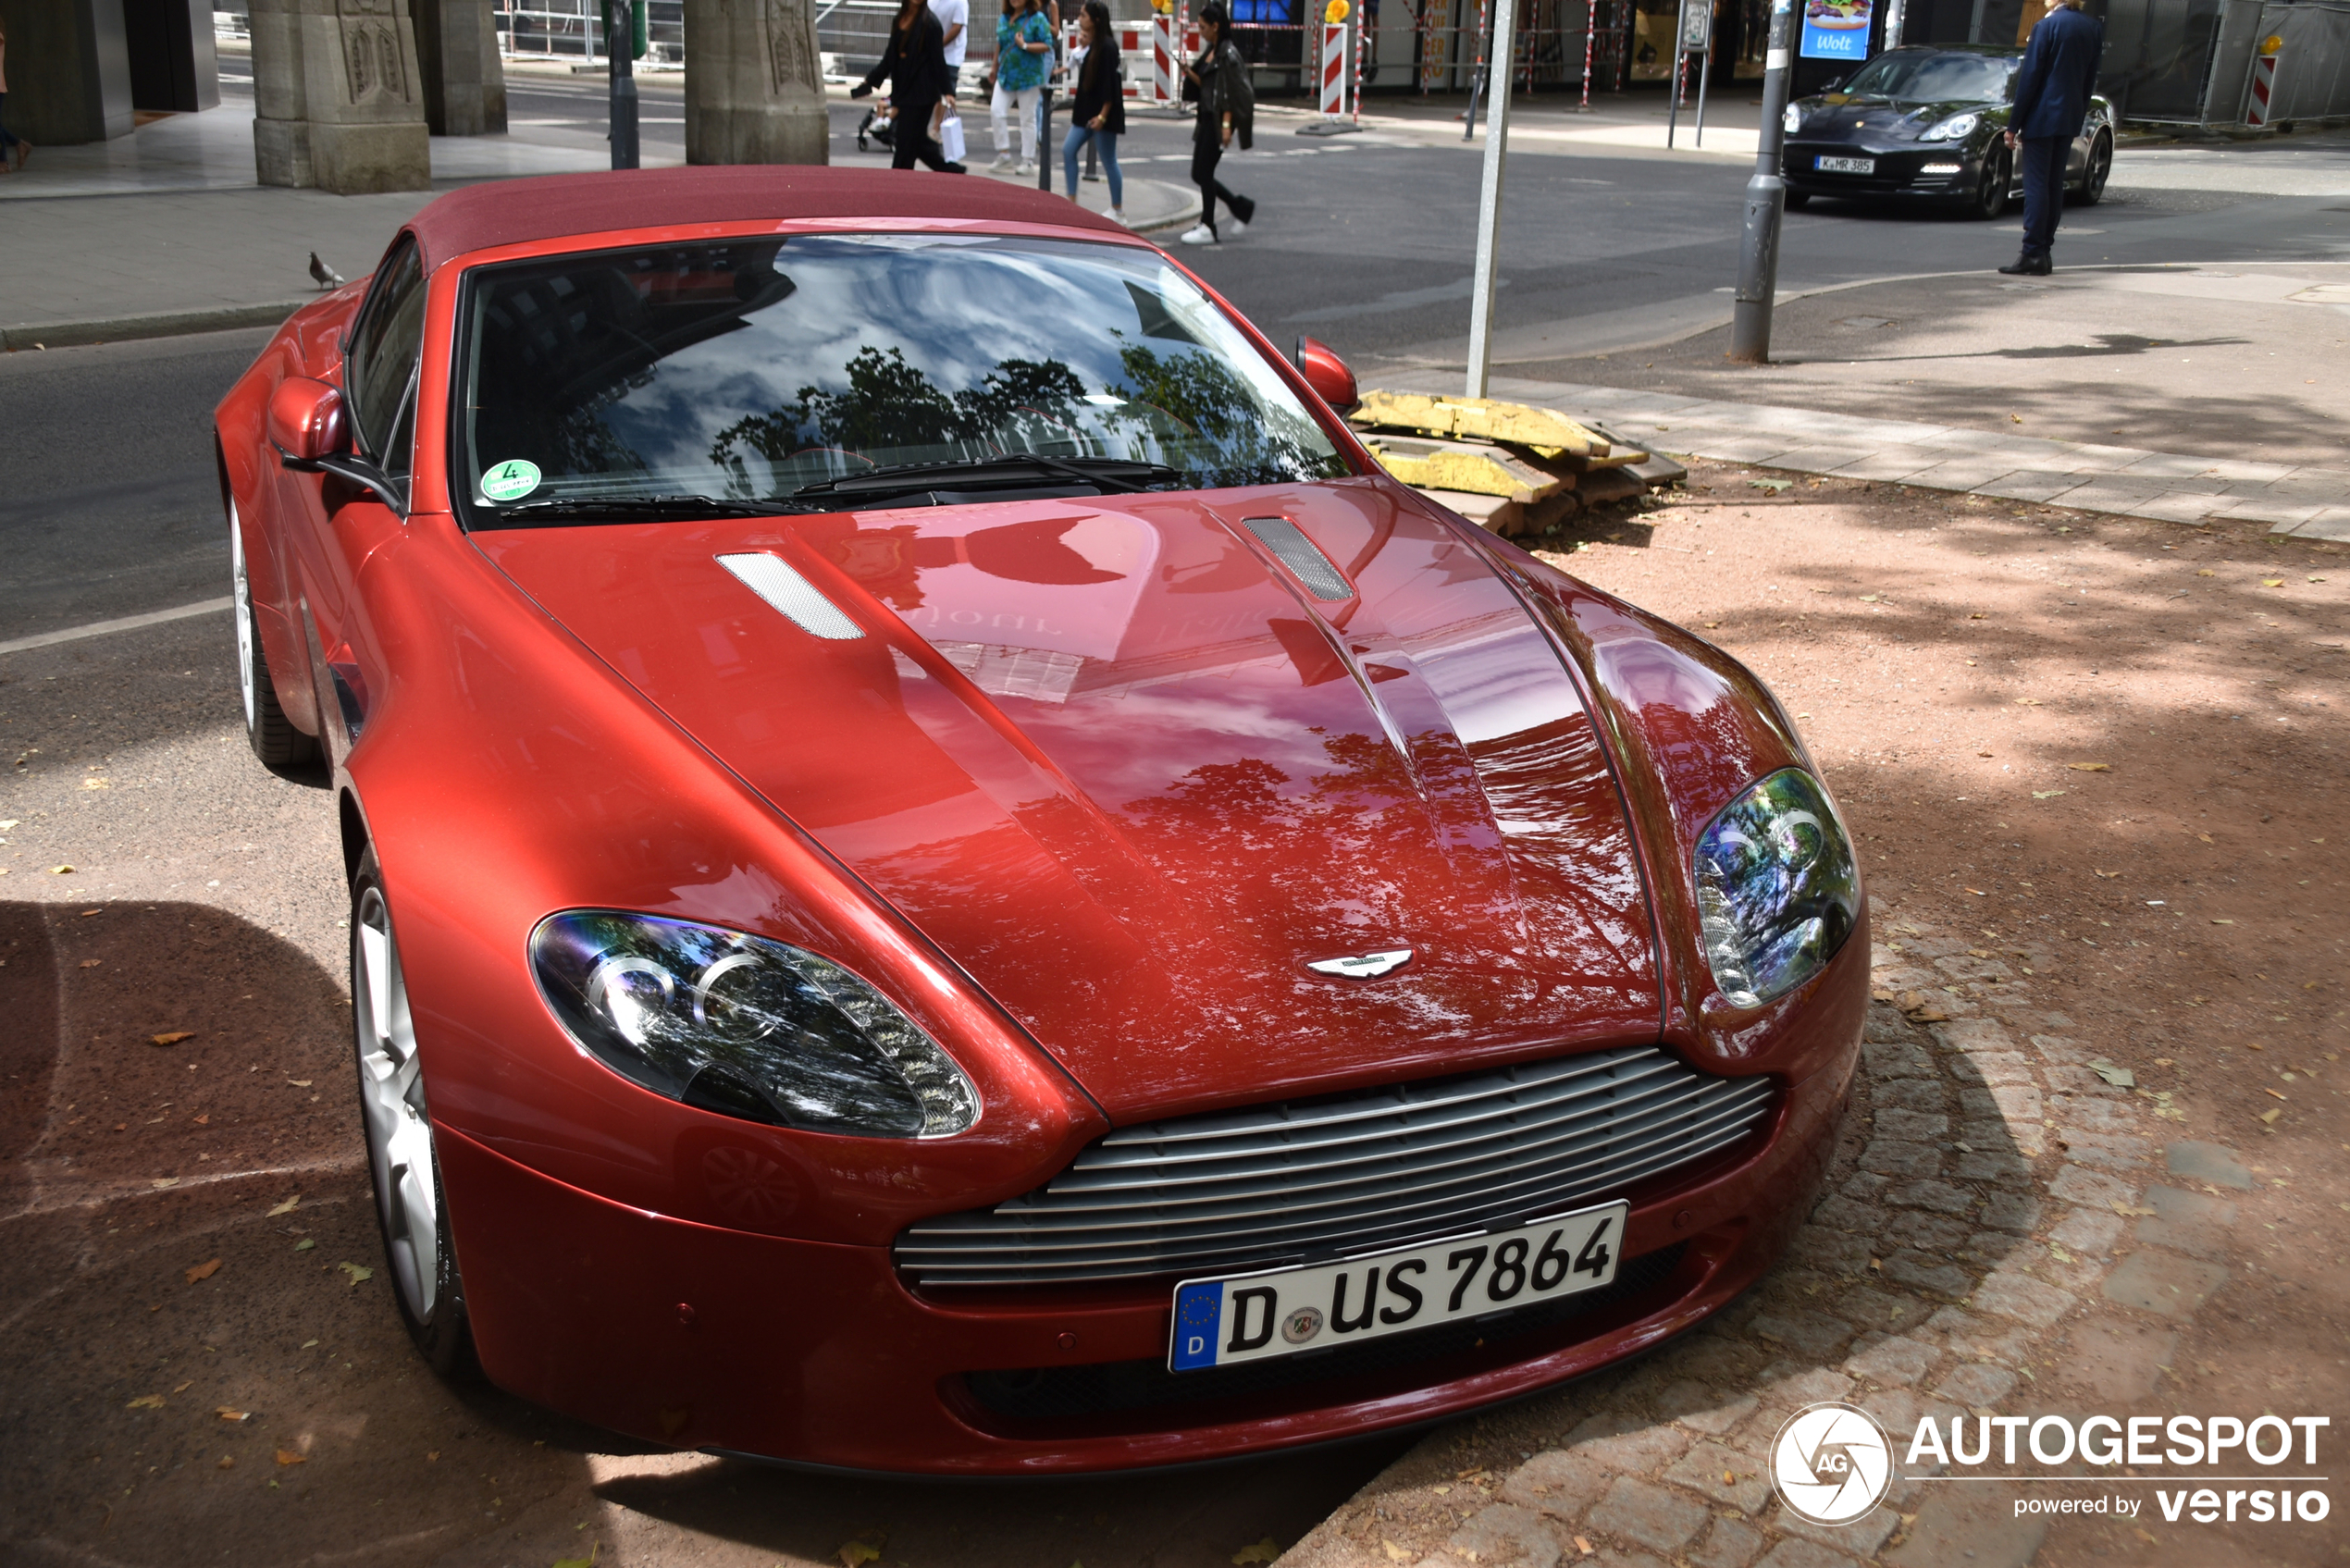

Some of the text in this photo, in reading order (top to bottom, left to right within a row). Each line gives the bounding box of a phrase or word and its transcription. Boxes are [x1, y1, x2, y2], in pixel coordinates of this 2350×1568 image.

[1817, 35, 1852, 50] Wolt
[1823, 157, 1870, 171] K MR 385
[502, 463, 518, 478] 4
[1227, 1285, 1278, 1352] D
[1330, 1258, 1427, 1333] US
[1447, 1216, 1614, 1312] 7864
[1187, 1336, 1205, 1355] D
